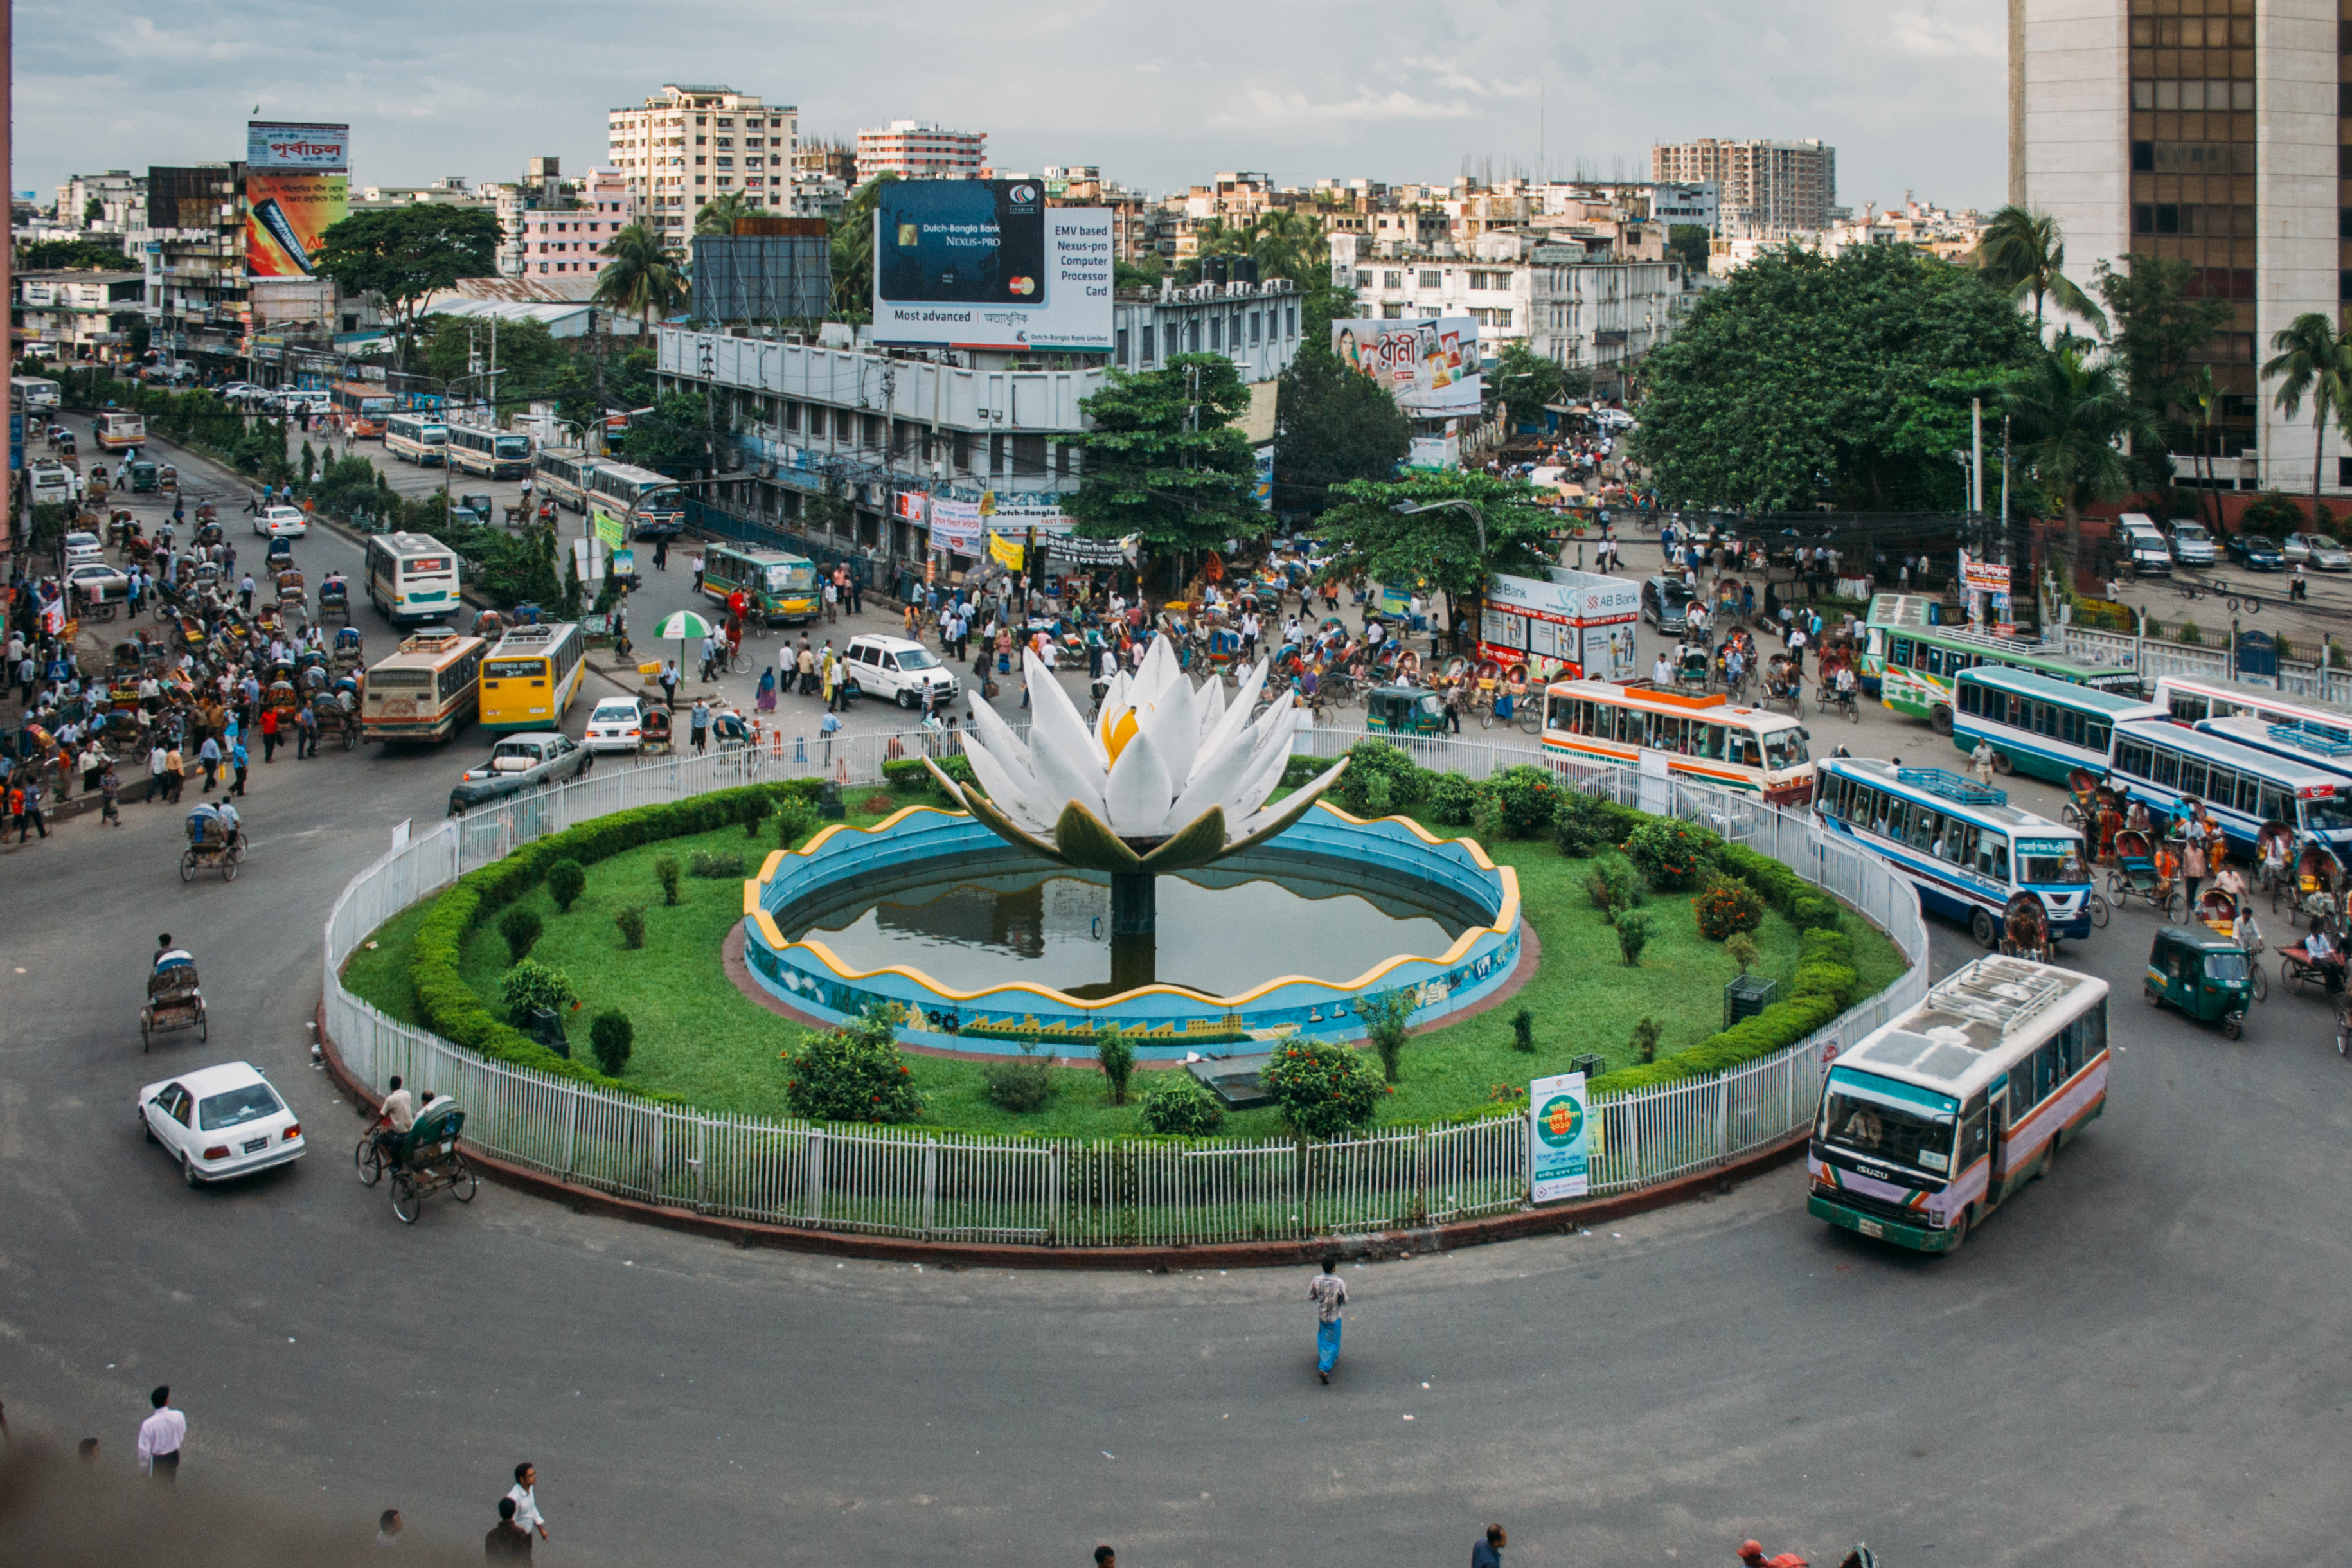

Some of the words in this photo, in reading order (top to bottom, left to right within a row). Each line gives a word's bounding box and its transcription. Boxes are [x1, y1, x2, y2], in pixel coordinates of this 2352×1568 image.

[270, 140, 343, 159] পূর্বাচল
[923, 224, 978, 234] Dutch-Bangla
[980, 224, 1001, 233] Bank
[1055, 226, 1077, 235] EMV
[1080, 226, 1107, 236] based
[1058, 242, 1107, 253] Nexus-pro
[1061, 256, 1107, 267] Computer
[1062, 271, 1107, 281] Processor
[1086, 286, 1107, 296] Card
[895, 310, 920, 321] Most
[923, 310, 970, 322] advanced
[984, 311, 1028, 326] অত্যাধুনিক
[1379, 333, 1418, 369] রানী
[995, 509, 1055, 517] Dutch-Bangla
[1489, 584, 1502, 594] AB
[1504, 584, 1527, 600] Bank
[1600, 595, 1613, 607] AB
[1616, 592, 1638, 605] Bank
[1549, 1101, 1570, 1112] জাতীয়
[1550, 1121, 1570, 1131] ২০১০
[1857, 1164, 1888, 1180] ISUZU
